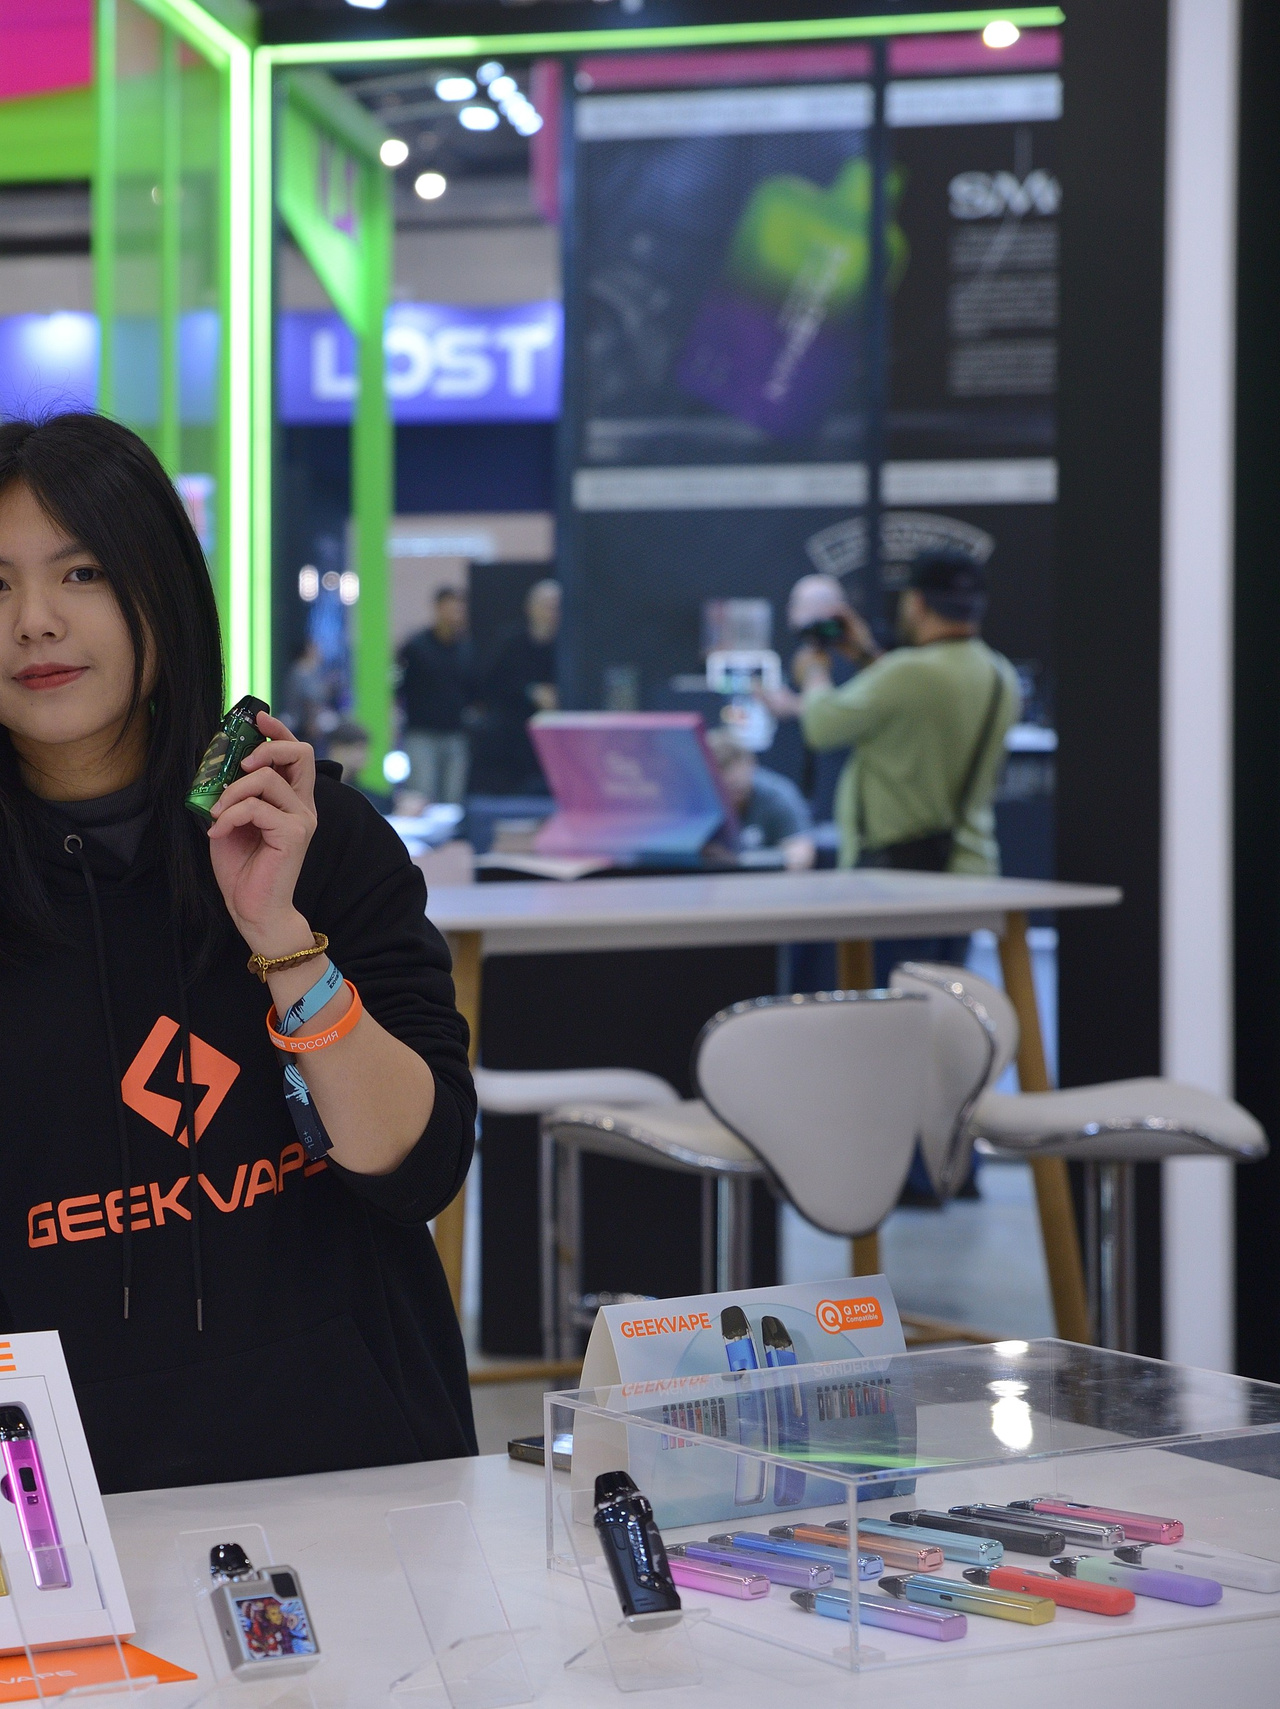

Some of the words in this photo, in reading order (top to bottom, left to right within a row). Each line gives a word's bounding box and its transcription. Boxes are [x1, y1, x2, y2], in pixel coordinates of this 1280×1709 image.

[311, 324, 556, 398] LOST
[290, 1030, 339, 1051] РОССИЯ
[303, 1130, 315, 1150] 18+
[27, 1142, 328, 1248] GEEKVAP
[843, 1305, 852, 1315] Q
[854, 1302, 875, 1314] POD
[845, 1313, 878, 1323] Compatible
[620, 1312, 712, 1339] GEEKVAPE
